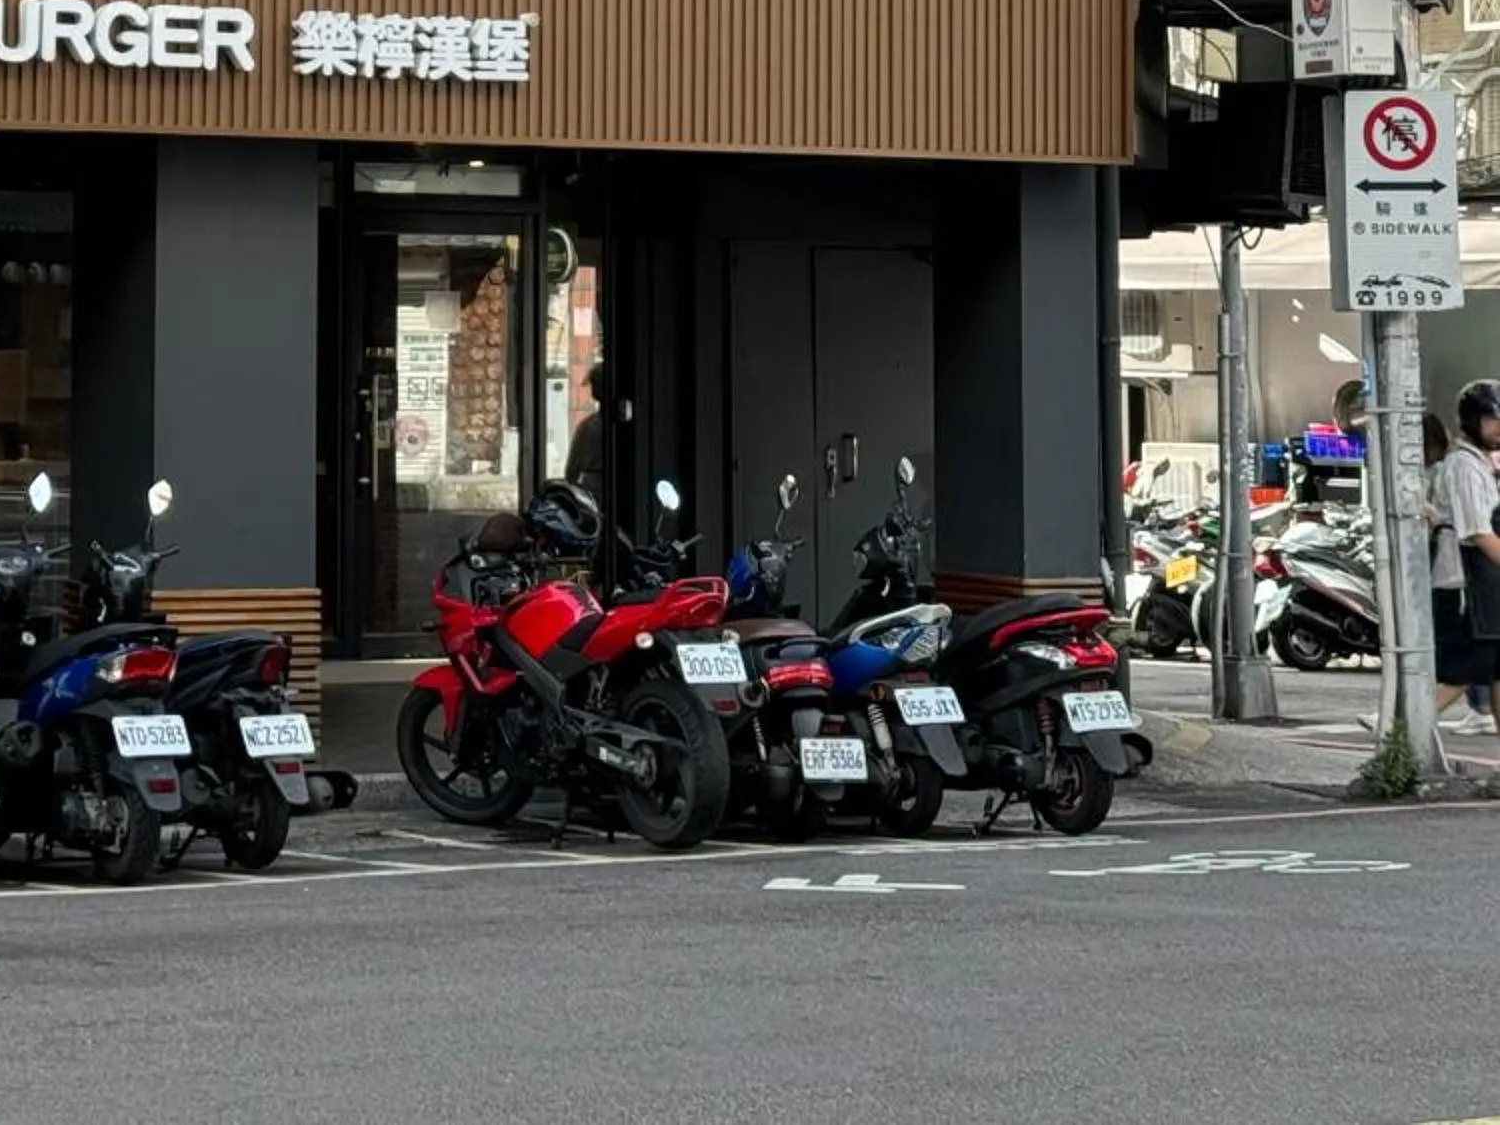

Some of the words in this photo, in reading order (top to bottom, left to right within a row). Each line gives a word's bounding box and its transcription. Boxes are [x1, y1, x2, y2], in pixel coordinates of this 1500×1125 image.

[291, 10, 530, 83] 樂檸漢堡
[1371, 222, 1453, 236] SIDEWALK
[1385, 289, 1444, 306] 1999
